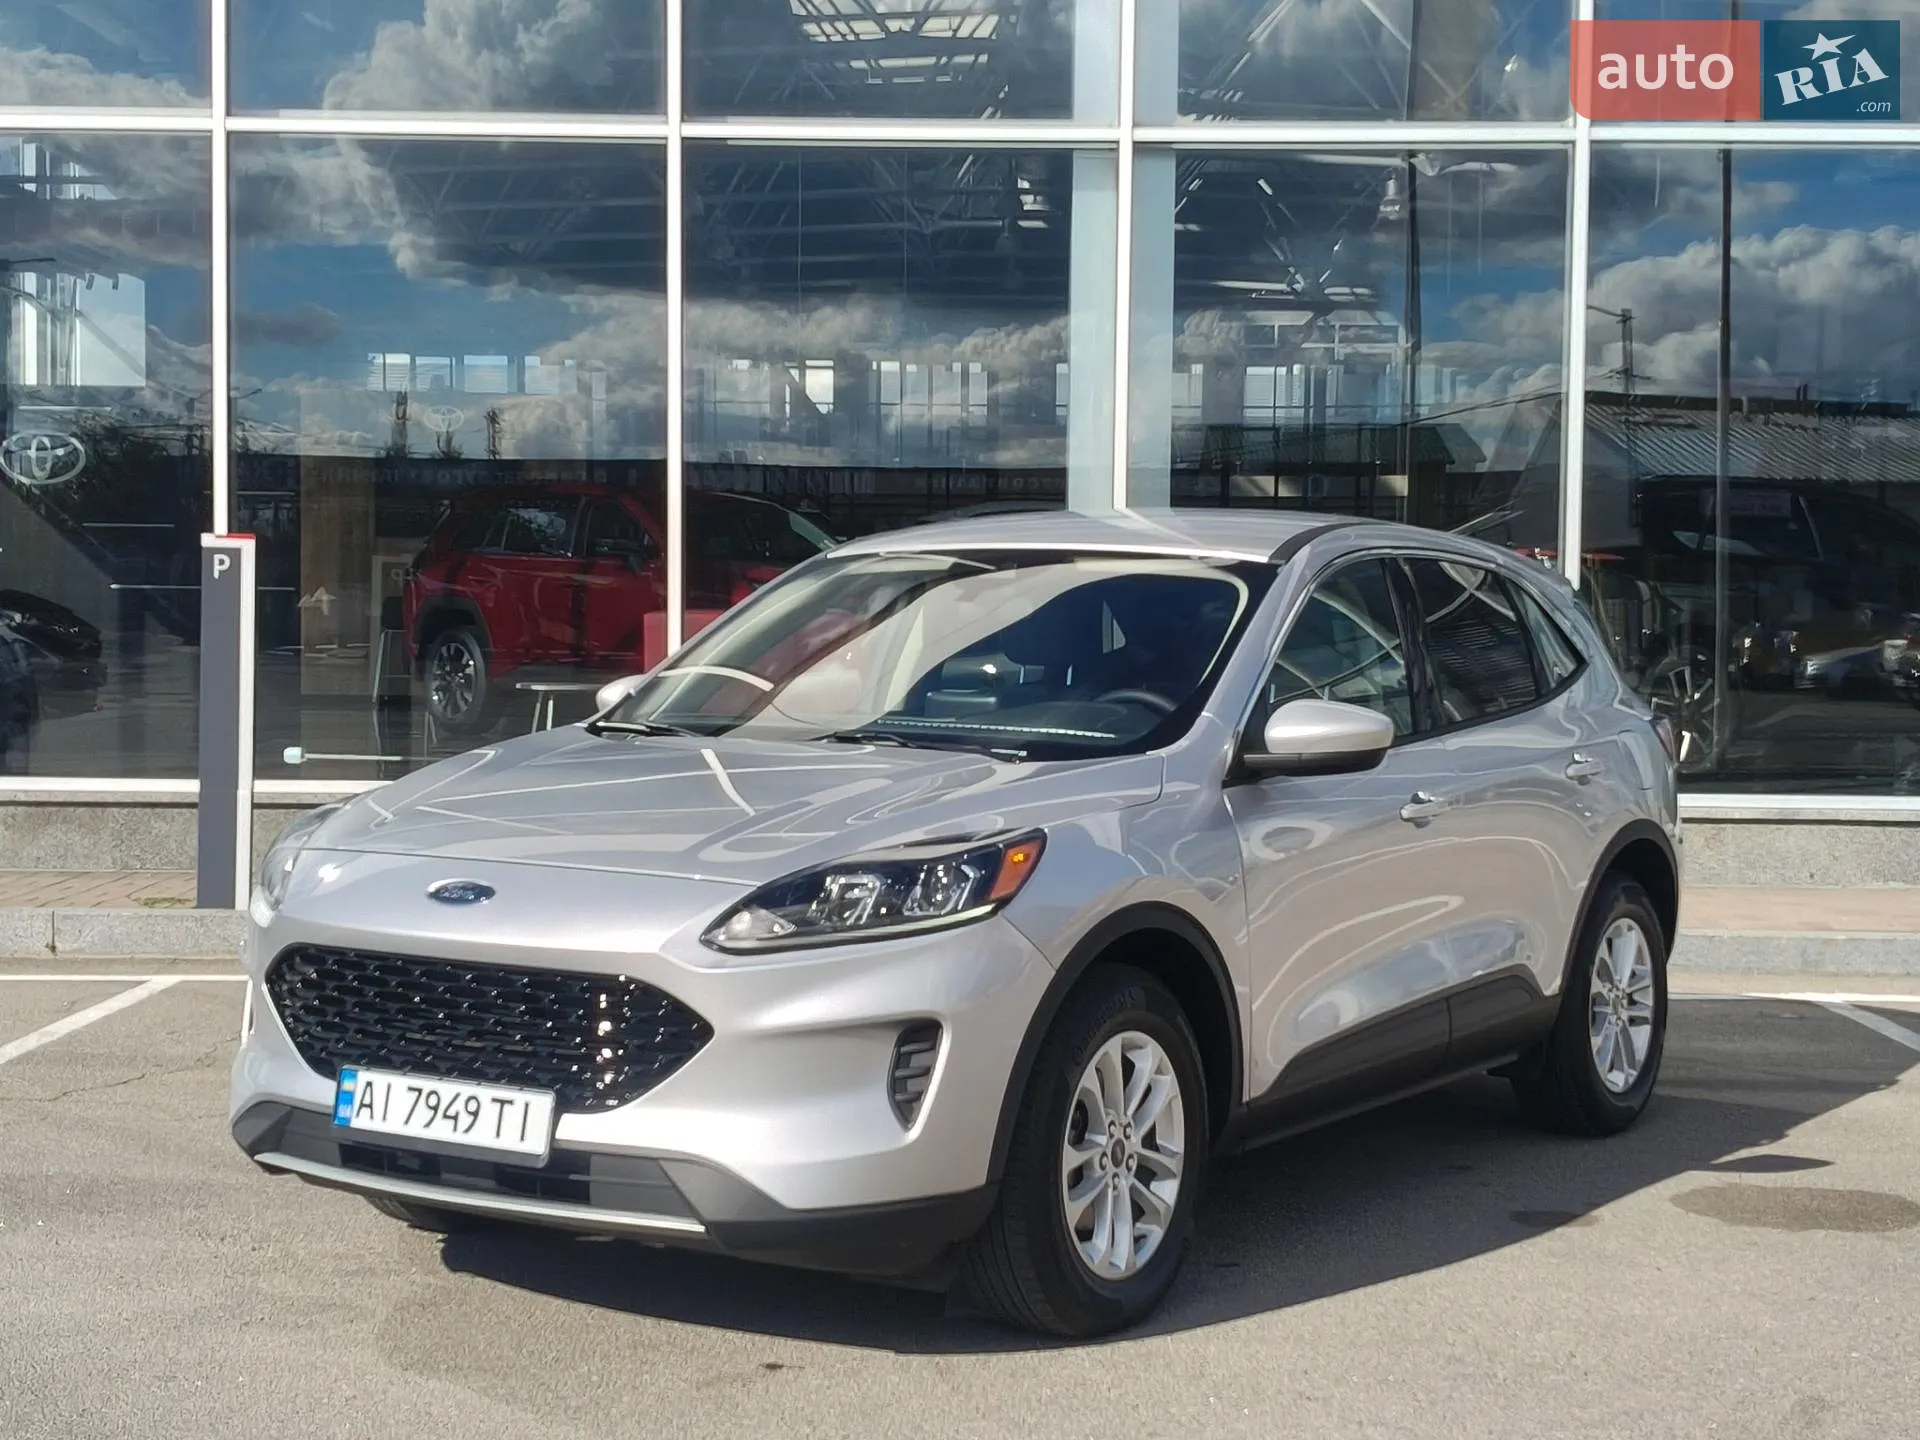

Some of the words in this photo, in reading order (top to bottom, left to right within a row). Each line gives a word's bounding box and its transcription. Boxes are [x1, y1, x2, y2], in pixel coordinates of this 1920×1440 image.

[213, 553, 231, 580] P
[355, 1080, 392, 1123] AI
[403, 1086, 481, 1135] 7949
[490, 1098, 530, 1143] TI
